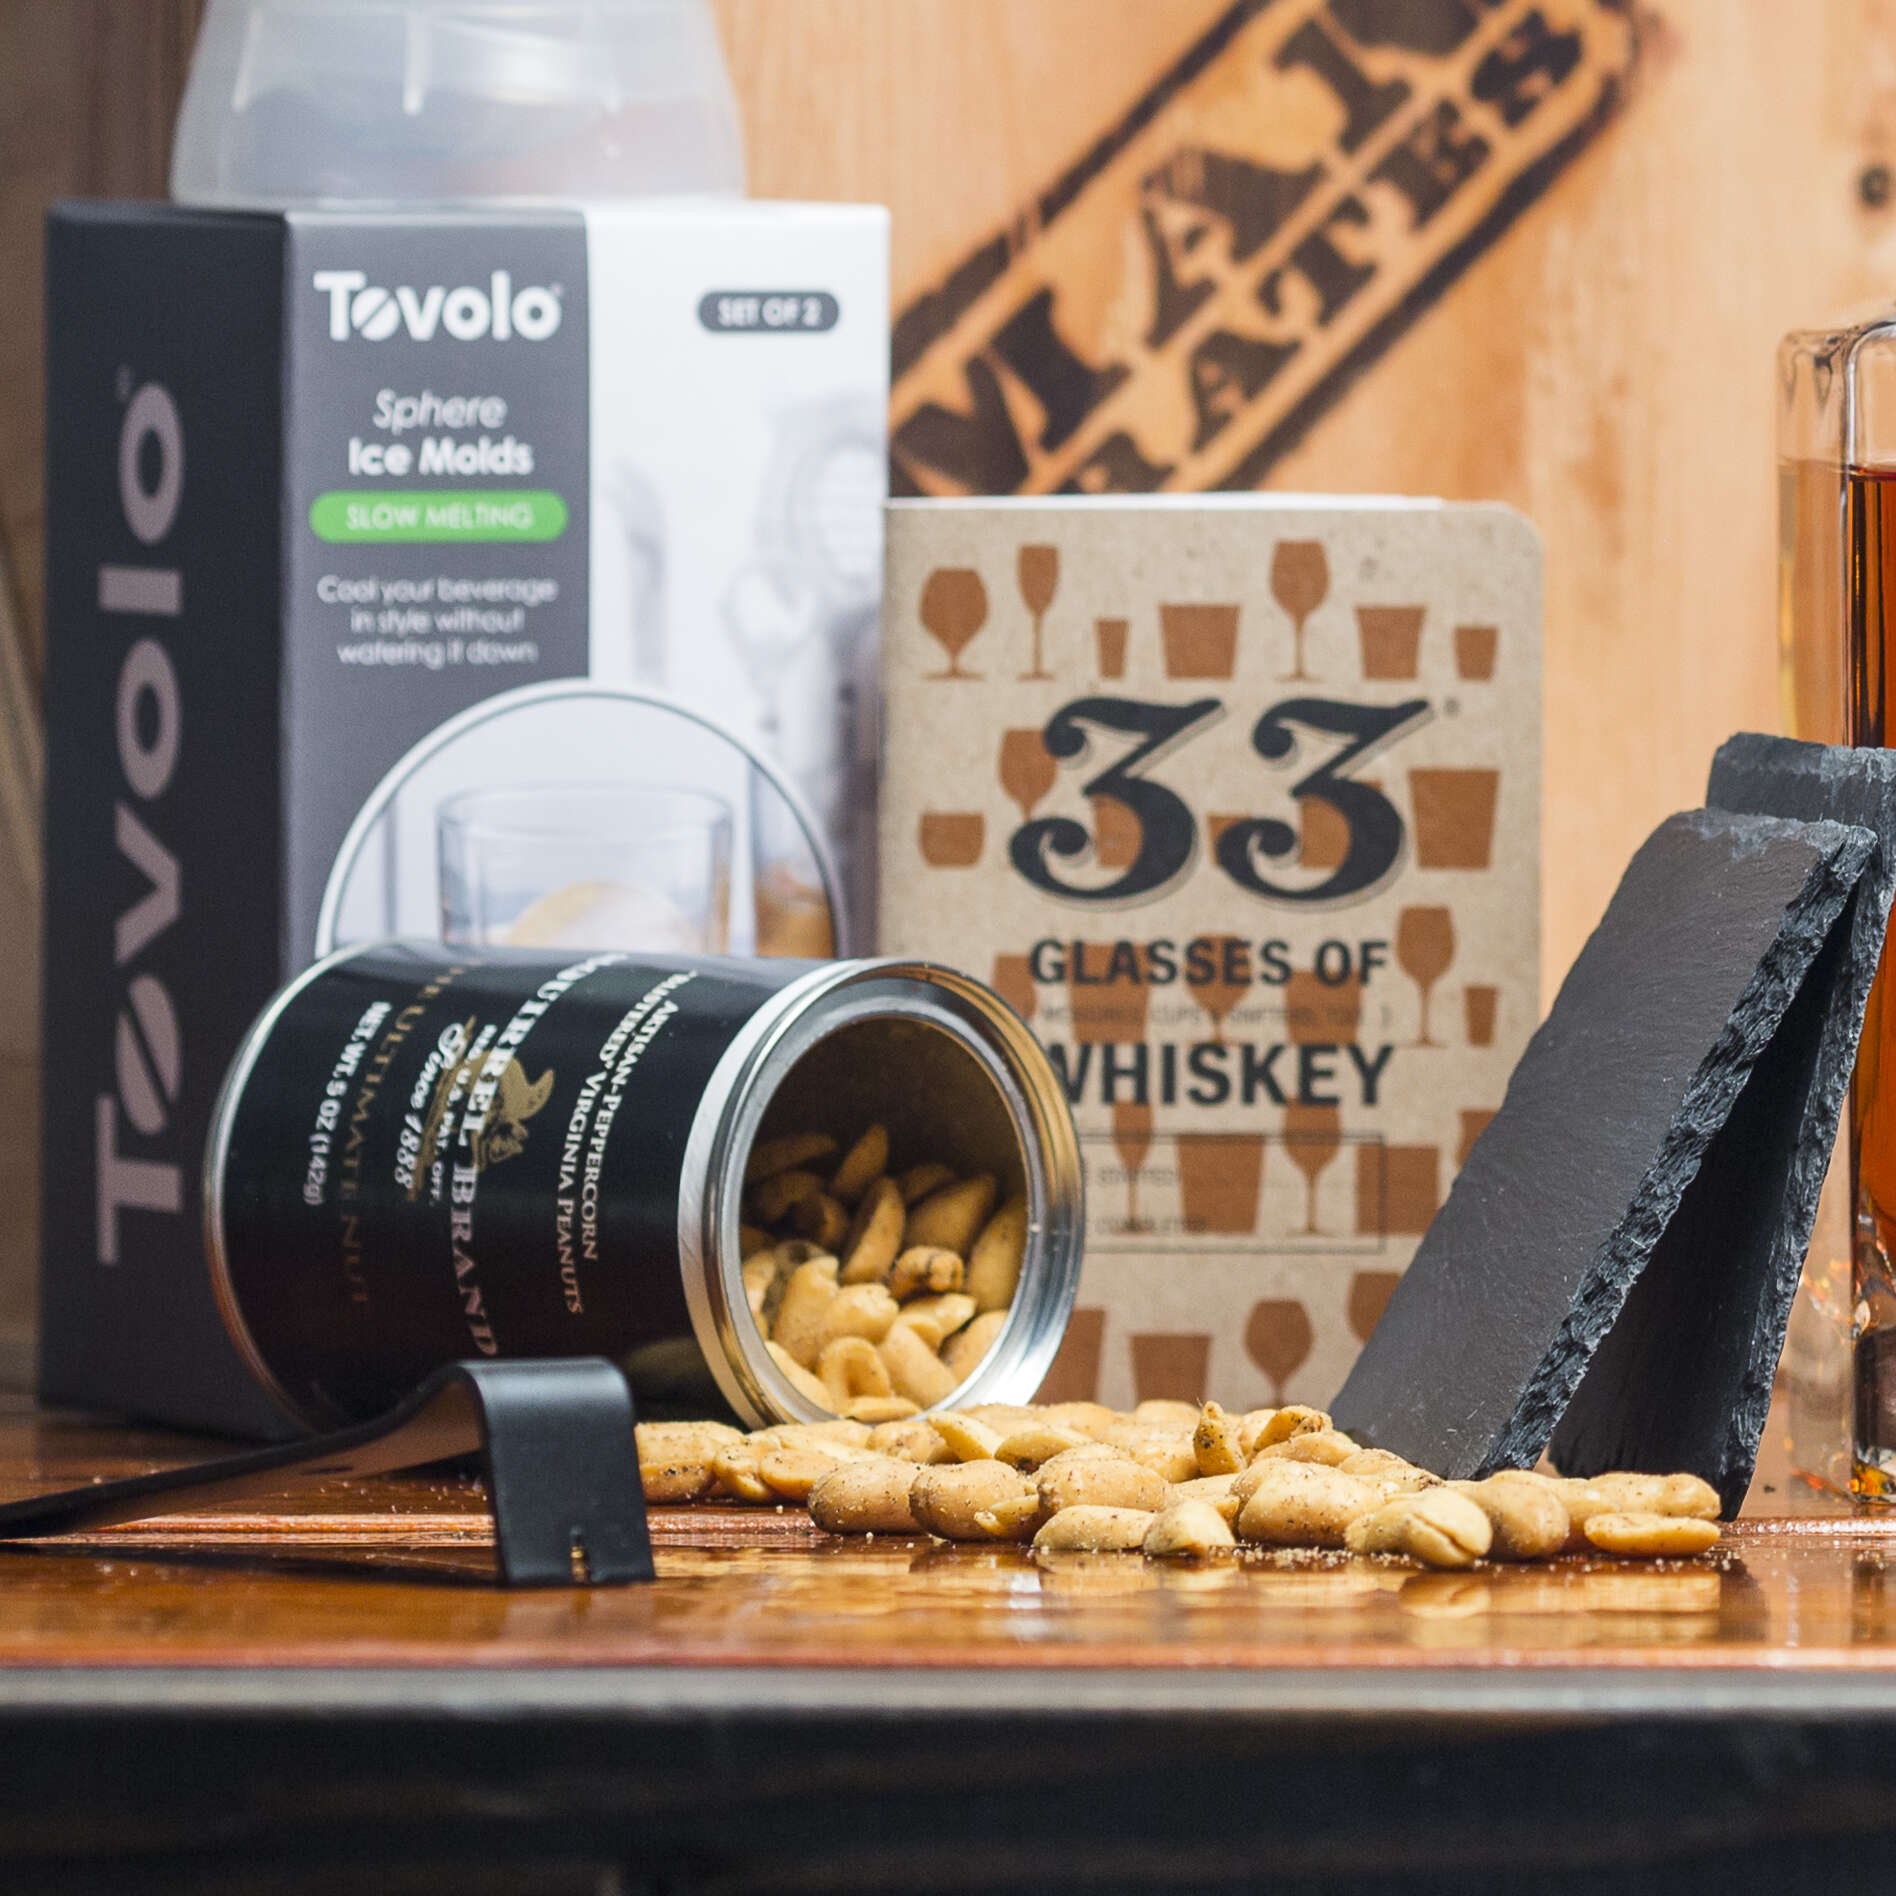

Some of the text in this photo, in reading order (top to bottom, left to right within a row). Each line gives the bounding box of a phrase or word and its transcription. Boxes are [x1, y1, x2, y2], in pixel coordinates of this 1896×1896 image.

[313, 270, 563, 342] Tovolo
[717, 296, 822, 327] SET OF 2
[372, 388, 509, 436] Sphere
[348, 435, 536, 476] Ice Molds
[345, 502, 535, 531] SLOW MELTING
[316, 574, 560, 607] Cool your beverage
[350, 607, 526, 638] in style without
[337, 637, 540, 671] watering it down
[96, 381, 185, 1266] Tovolo
[1008, 694, 1440, 912] 33
[1029, 938, 1390, 987] GLASSES OF
[1048, 1042, 1395, 1105] WHISKEY
[316, 1098, 343, 1132] OZ
[393, 1021, 467, 1191] Since 1888
[557, 1072, 607, 1192] VIRGINIA
[303, 1132, 332, 1207] (142g)
[450, 953, 628, 1357] UIRREL BRAND
[557, 1198, 585, 1315] PEANUTS
